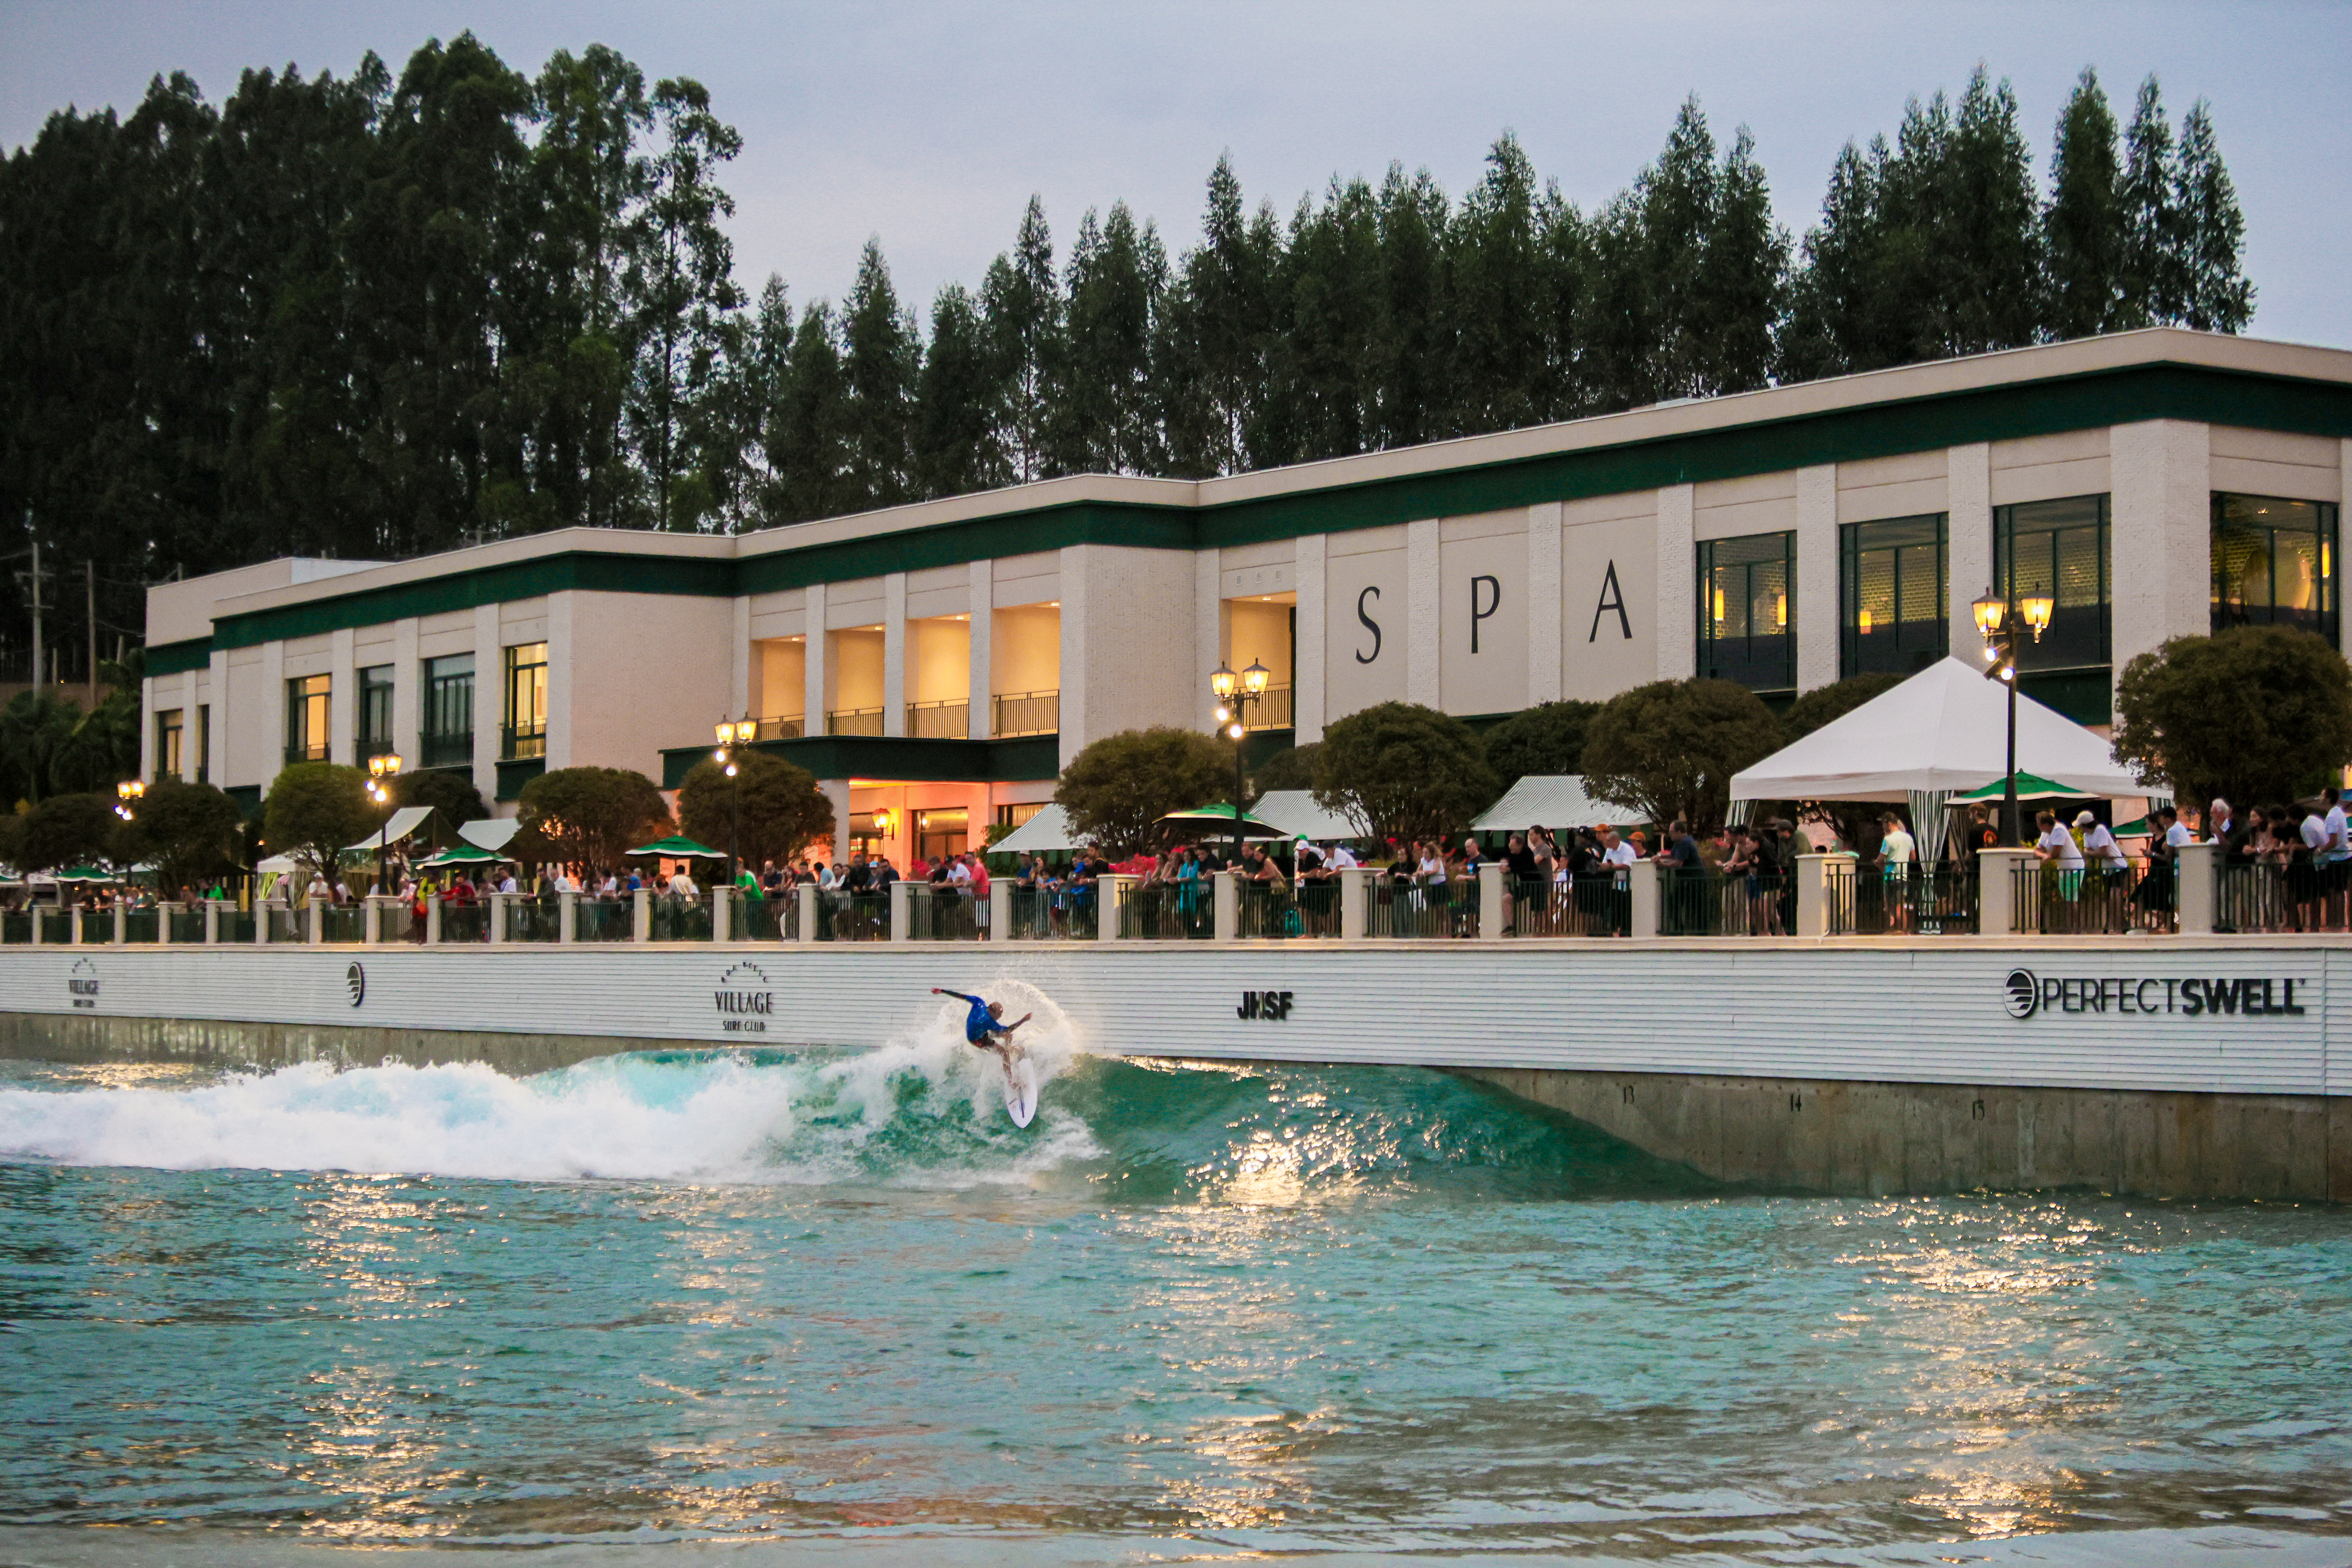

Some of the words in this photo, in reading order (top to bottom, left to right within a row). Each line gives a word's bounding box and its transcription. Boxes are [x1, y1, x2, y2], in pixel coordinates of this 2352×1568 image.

[1356, 558, 1632, 664] SPA
[714, 991, 773, 1014] VILLAGE
[1237, 991, 1293, 1020] JHSF
[2042, 978, 2305, 1016] PERFECTSWELL
[723, 1020, 741, 1031] SURF
[744, 1021, 766, 1032] CLUB
[1790, 1093, 1802, 1112] 14
